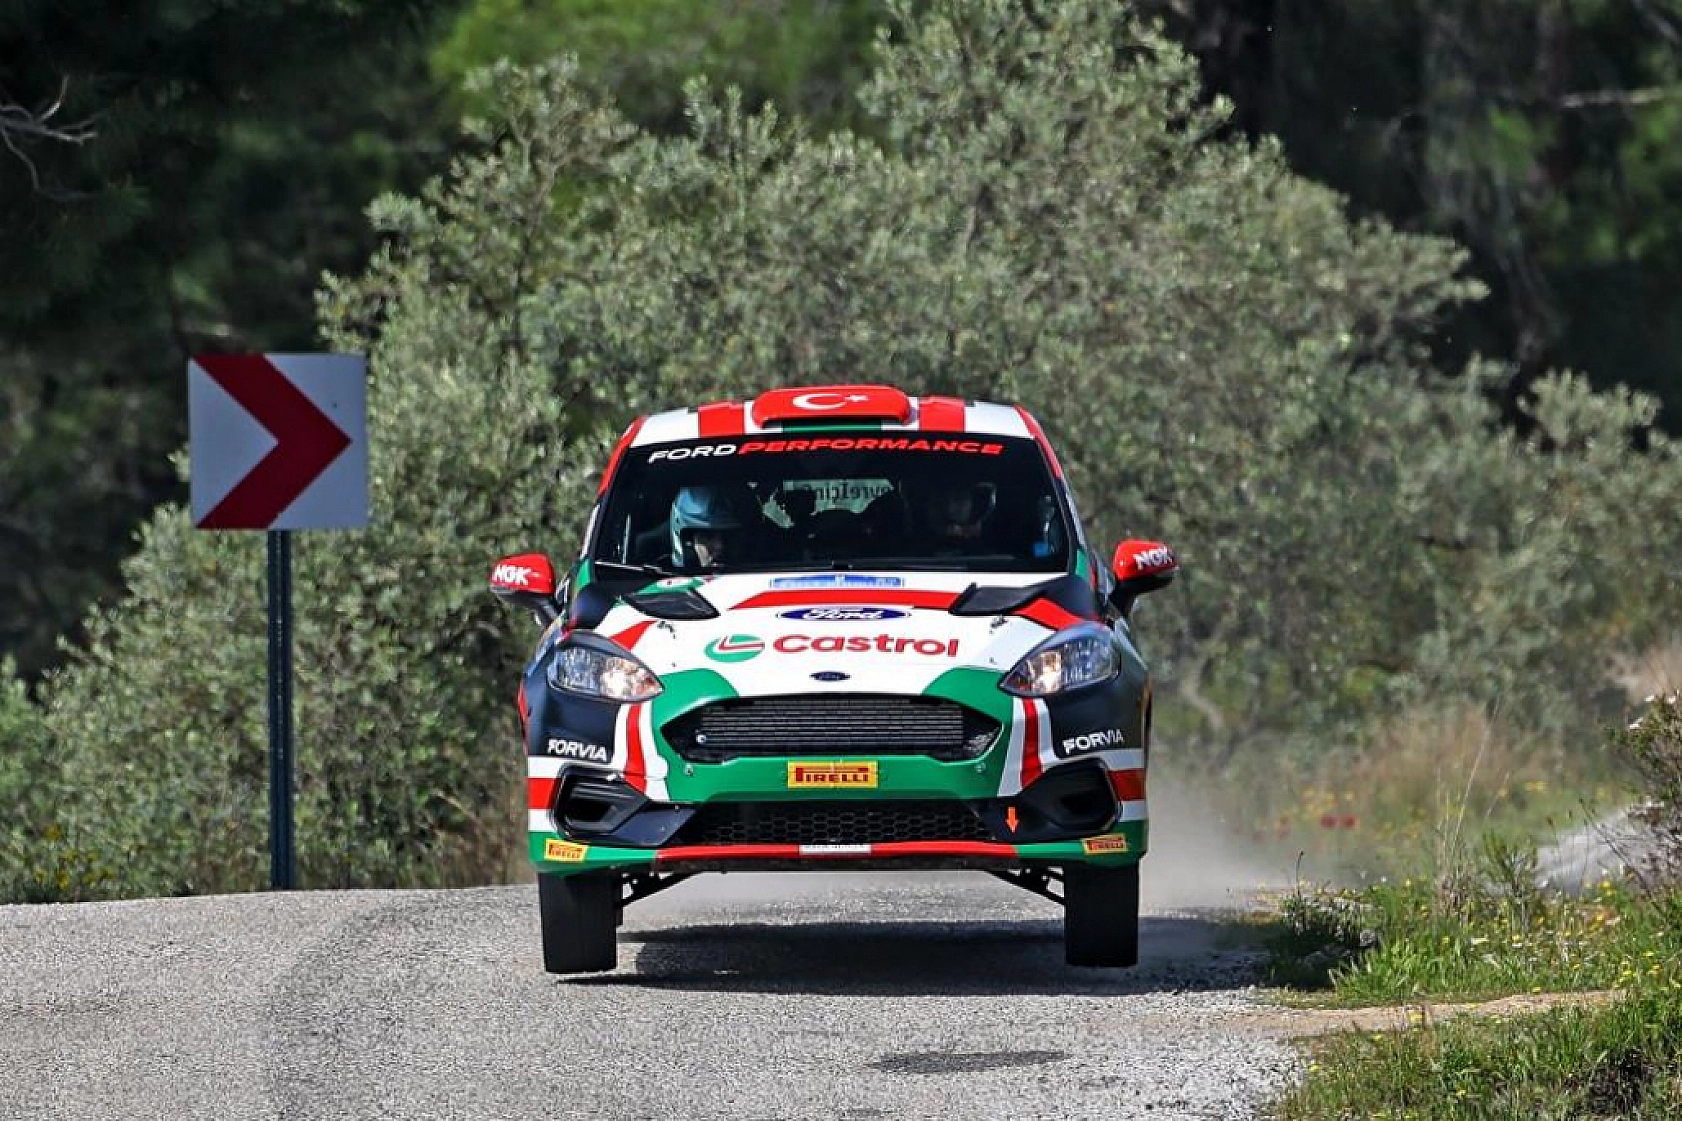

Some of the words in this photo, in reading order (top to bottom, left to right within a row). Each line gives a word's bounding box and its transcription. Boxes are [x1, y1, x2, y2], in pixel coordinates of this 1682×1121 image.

[648, 443, 737, 464] FORD
[738, 438, 1004, 455] PERFORMANCE
[1132, 545, 1173, 570] NGK
[492, 564, 531, 586] NGK
[773, 633, 960, 658] Castrol
[547, 739, 607, 762] FORVIA
[1063, 729, 1124, 755] FORVIA
[795, 766, 869, 783] PIRELLI
